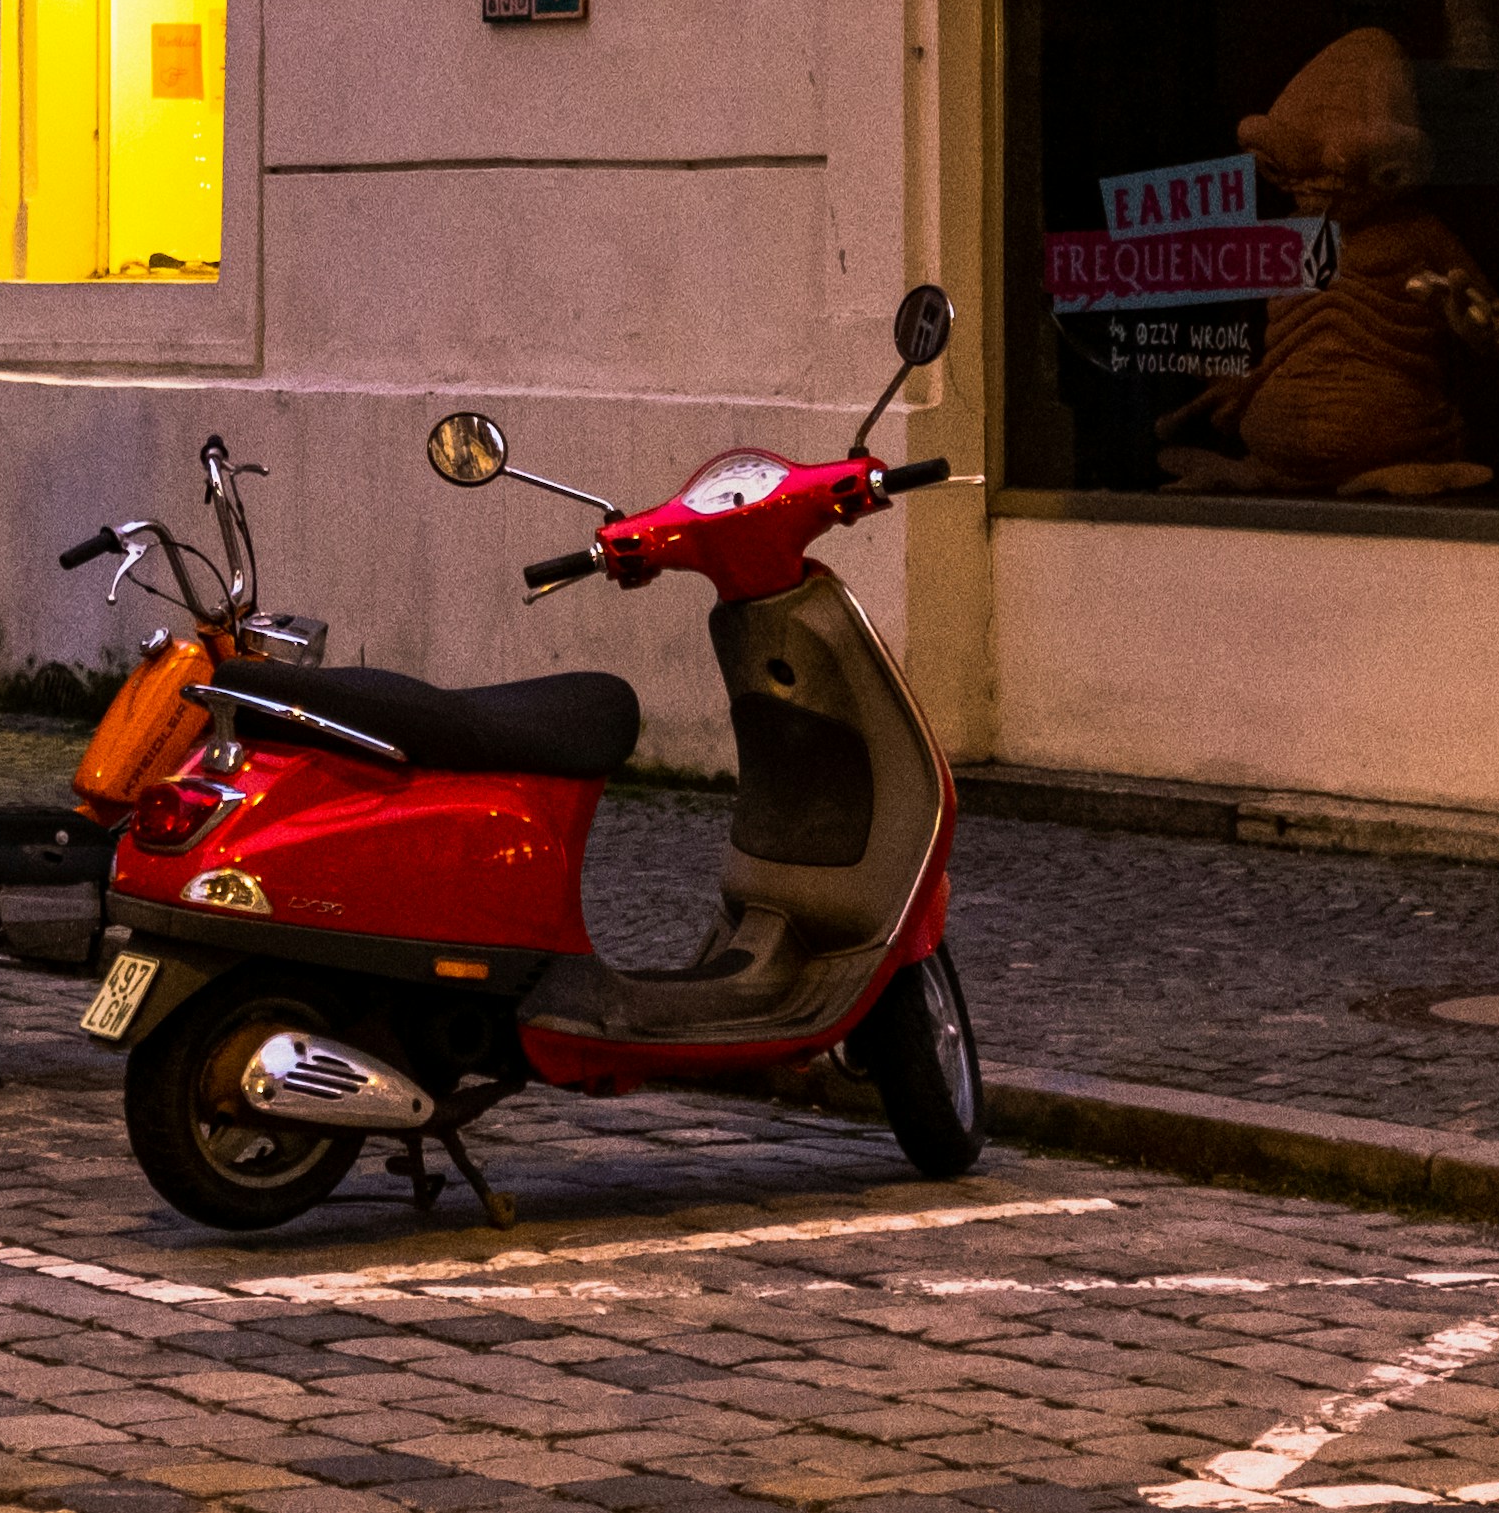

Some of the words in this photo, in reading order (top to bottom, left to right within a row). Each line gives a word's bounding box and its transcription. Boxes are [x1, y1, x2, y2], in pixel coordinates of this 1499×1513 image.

[1114, 170, 1245, 230] EARTH
[1051, 240, 1300, 291] FREQUENCIES
[1190, 322, 1252, 352] WRONG
[1136, 352, 1201, 375] VOLCOM
[1204, 354, 1251, 378] STONE
[107, 959, 152, 994] 497
[86, 995, 133, 1033] LGW
